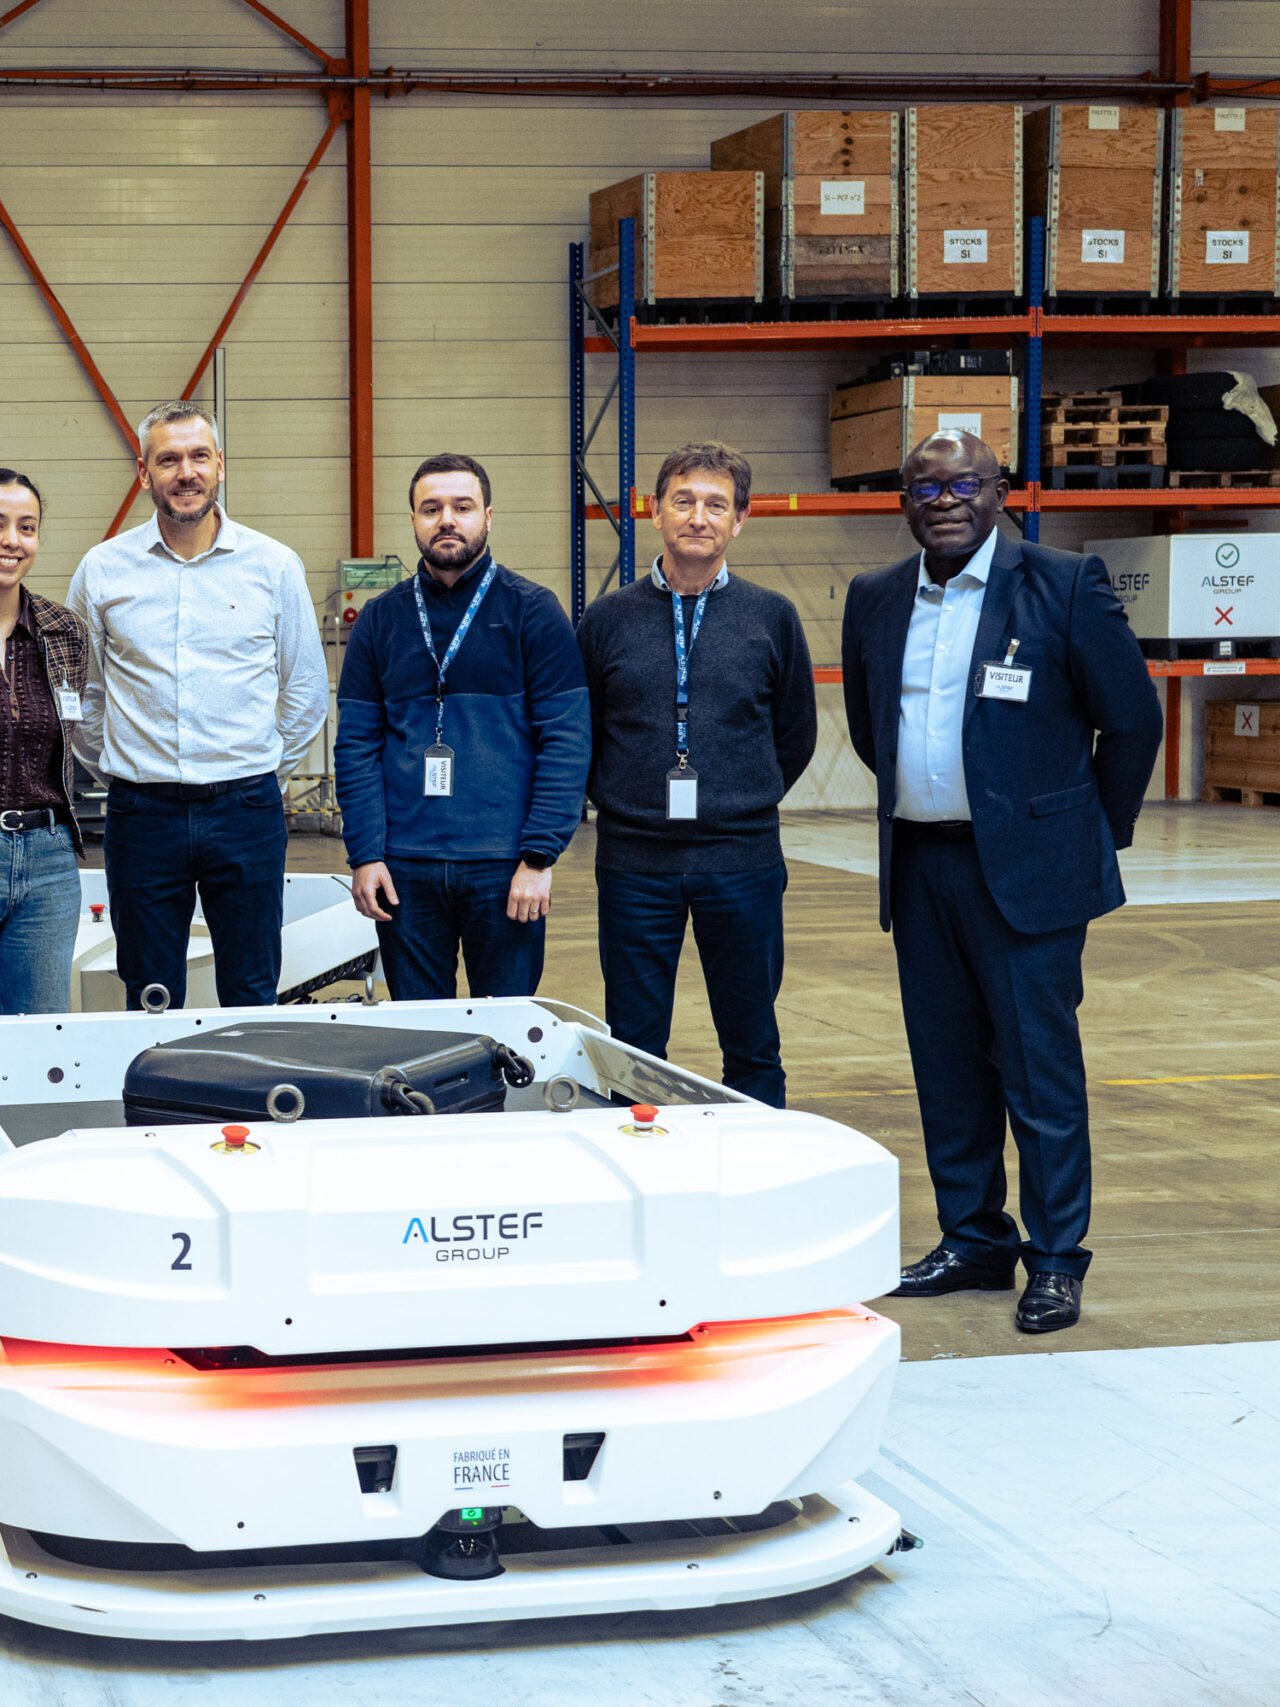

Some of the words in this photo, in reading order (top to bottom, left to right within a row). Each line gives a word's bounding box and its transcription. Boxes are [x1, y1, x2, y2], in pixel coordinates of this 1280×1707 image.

[949, 238, 982, 246] STOCKS
[1212, 239, 1244, 247] STOCKS
[960, 249, 971, 259] SI
[1097, 249, 1108, 259] SI
[1222, 250, 1233, 260] SI
[1111, 573, 1150, 591] LSTEF
[1201, 575, 1255, 588] ALSTEF
[989, 671, 1024, 683] VISITEUR
[402, 1212, 543, 1244] ALSTEF
[171, 1232, 192, 1270] 2
[435, 1247, 510, 1262] GROUP
[453, 1448, 496, 1463] FABRIQUÉ
[498, 1449, 510, 1460] EN
[454, 1463, 510, 1484] FRANCE
